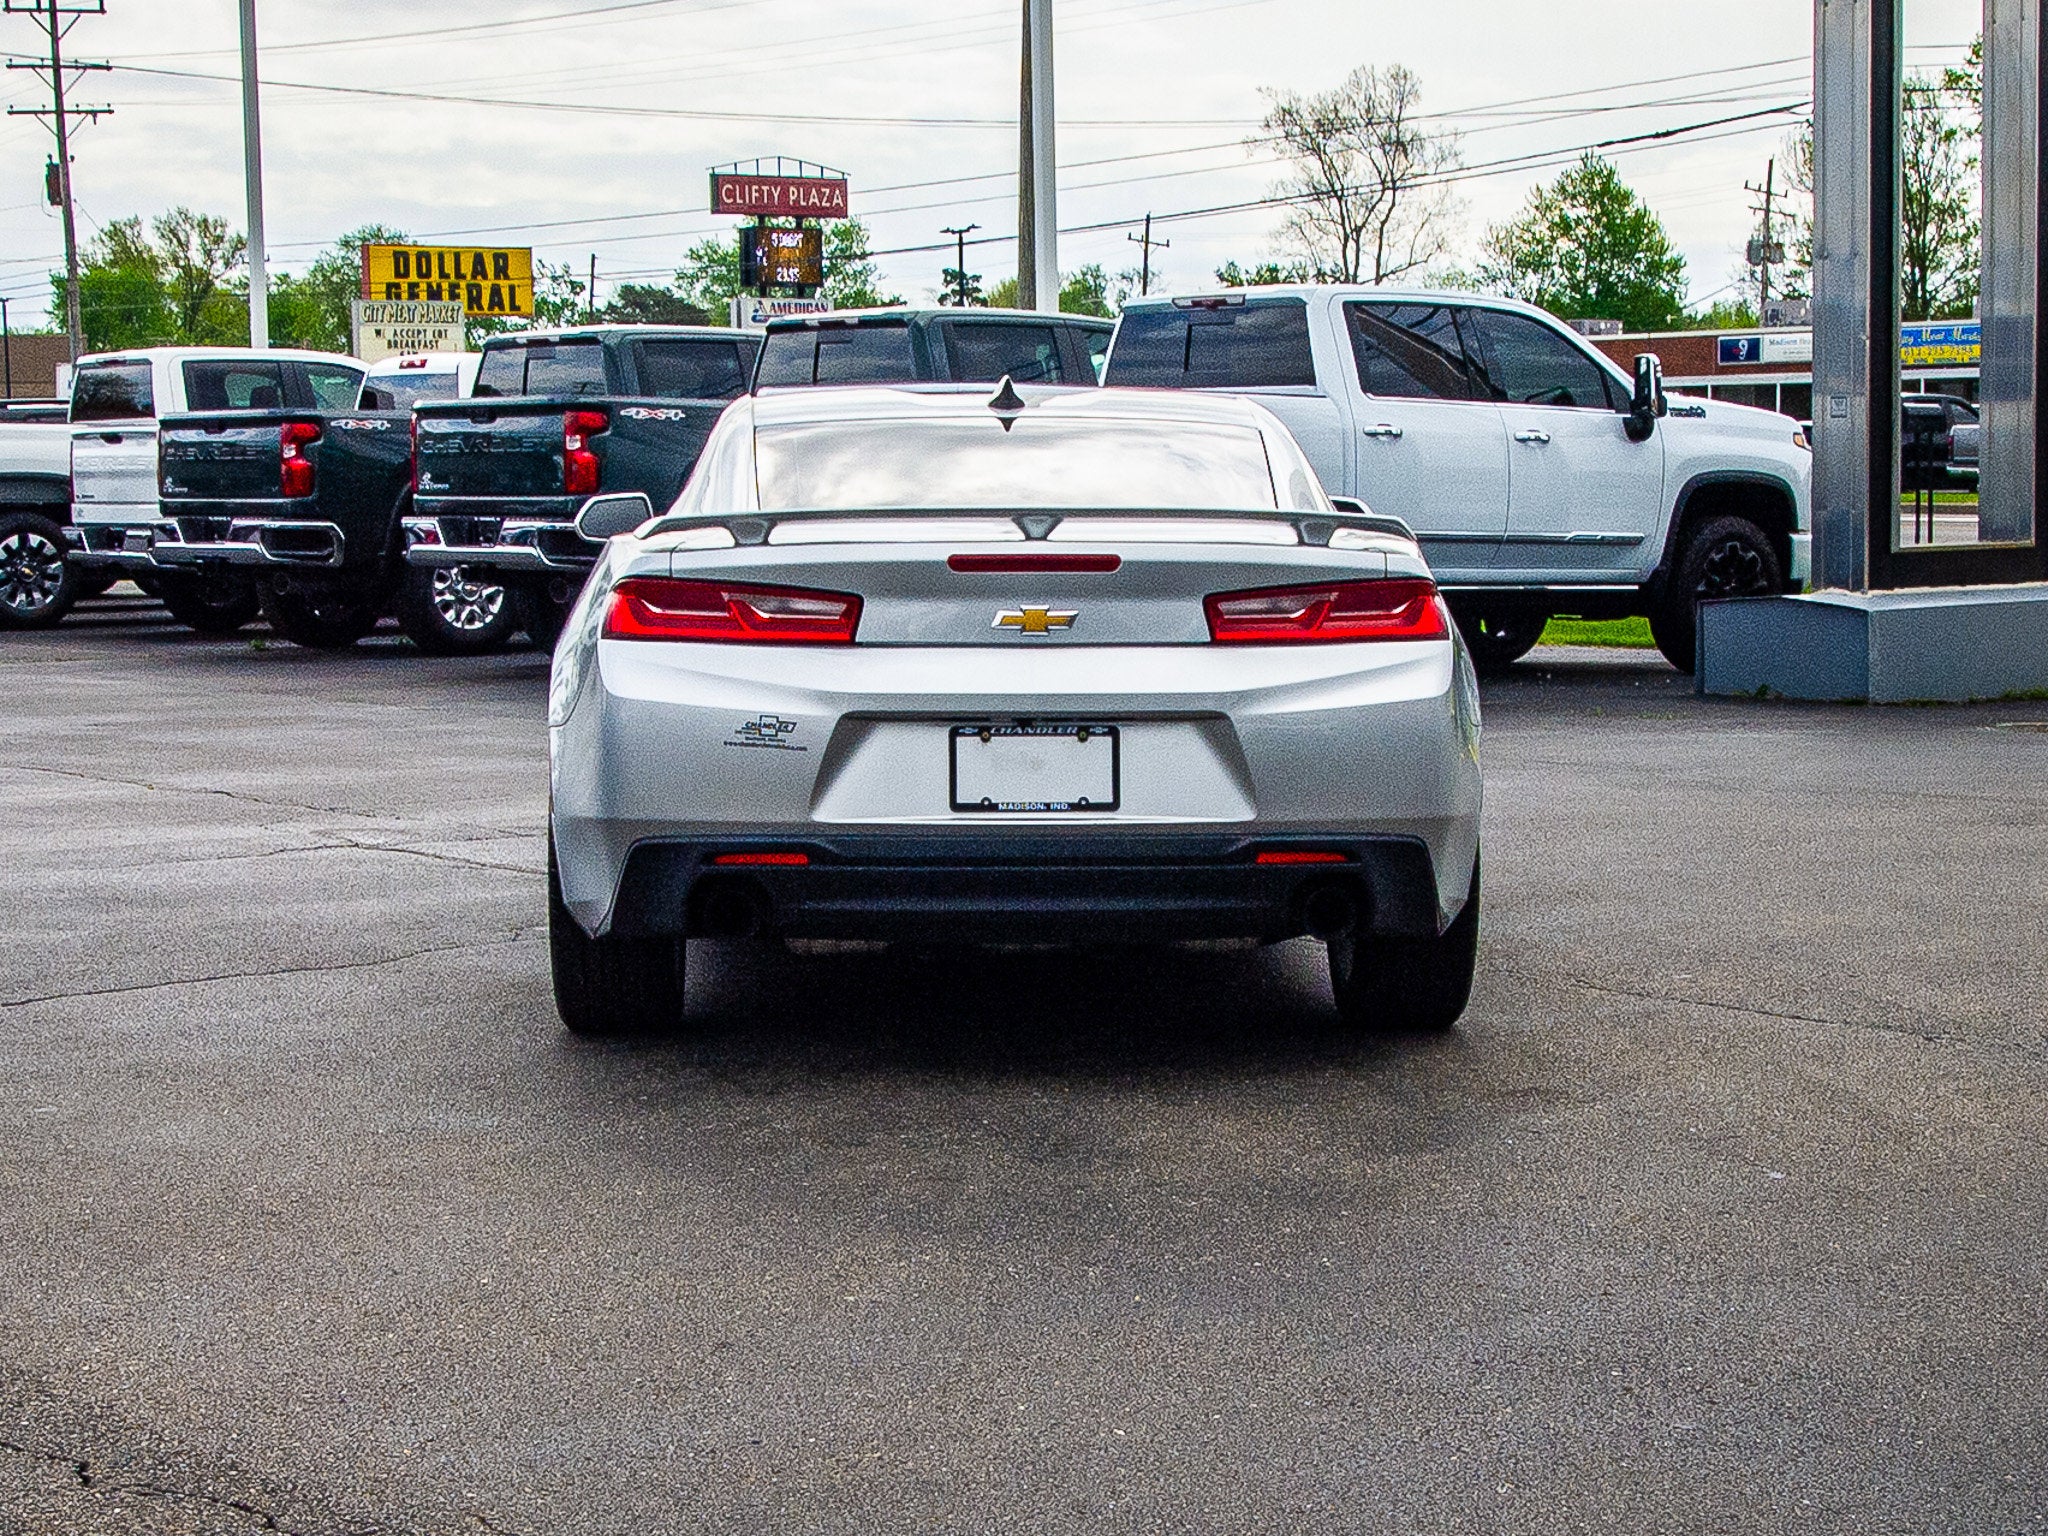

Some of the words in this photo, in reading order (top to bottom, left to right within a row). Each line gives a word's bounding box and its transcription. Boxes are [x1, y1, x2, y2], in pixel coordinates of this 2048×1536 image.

[721, 184, 781, 205] CLIFTY
[789, 187, 844, 208] PLAZA
[393, 249, 510, 280] DOLLAR
[385, 281, 521, 312] GENERAL
[362, 303, 386, 323] CITY
[386, 303, 417, 323] MEAT
[418, 303, 461, 323] MARKET
[770, 301, 828, 315] AMERICAN
[393, 328, 427, 339] ACCEPT
[386, 339, 440, 350] BREAKFAST
[990, 726, 1079, 734] CHANDLER
